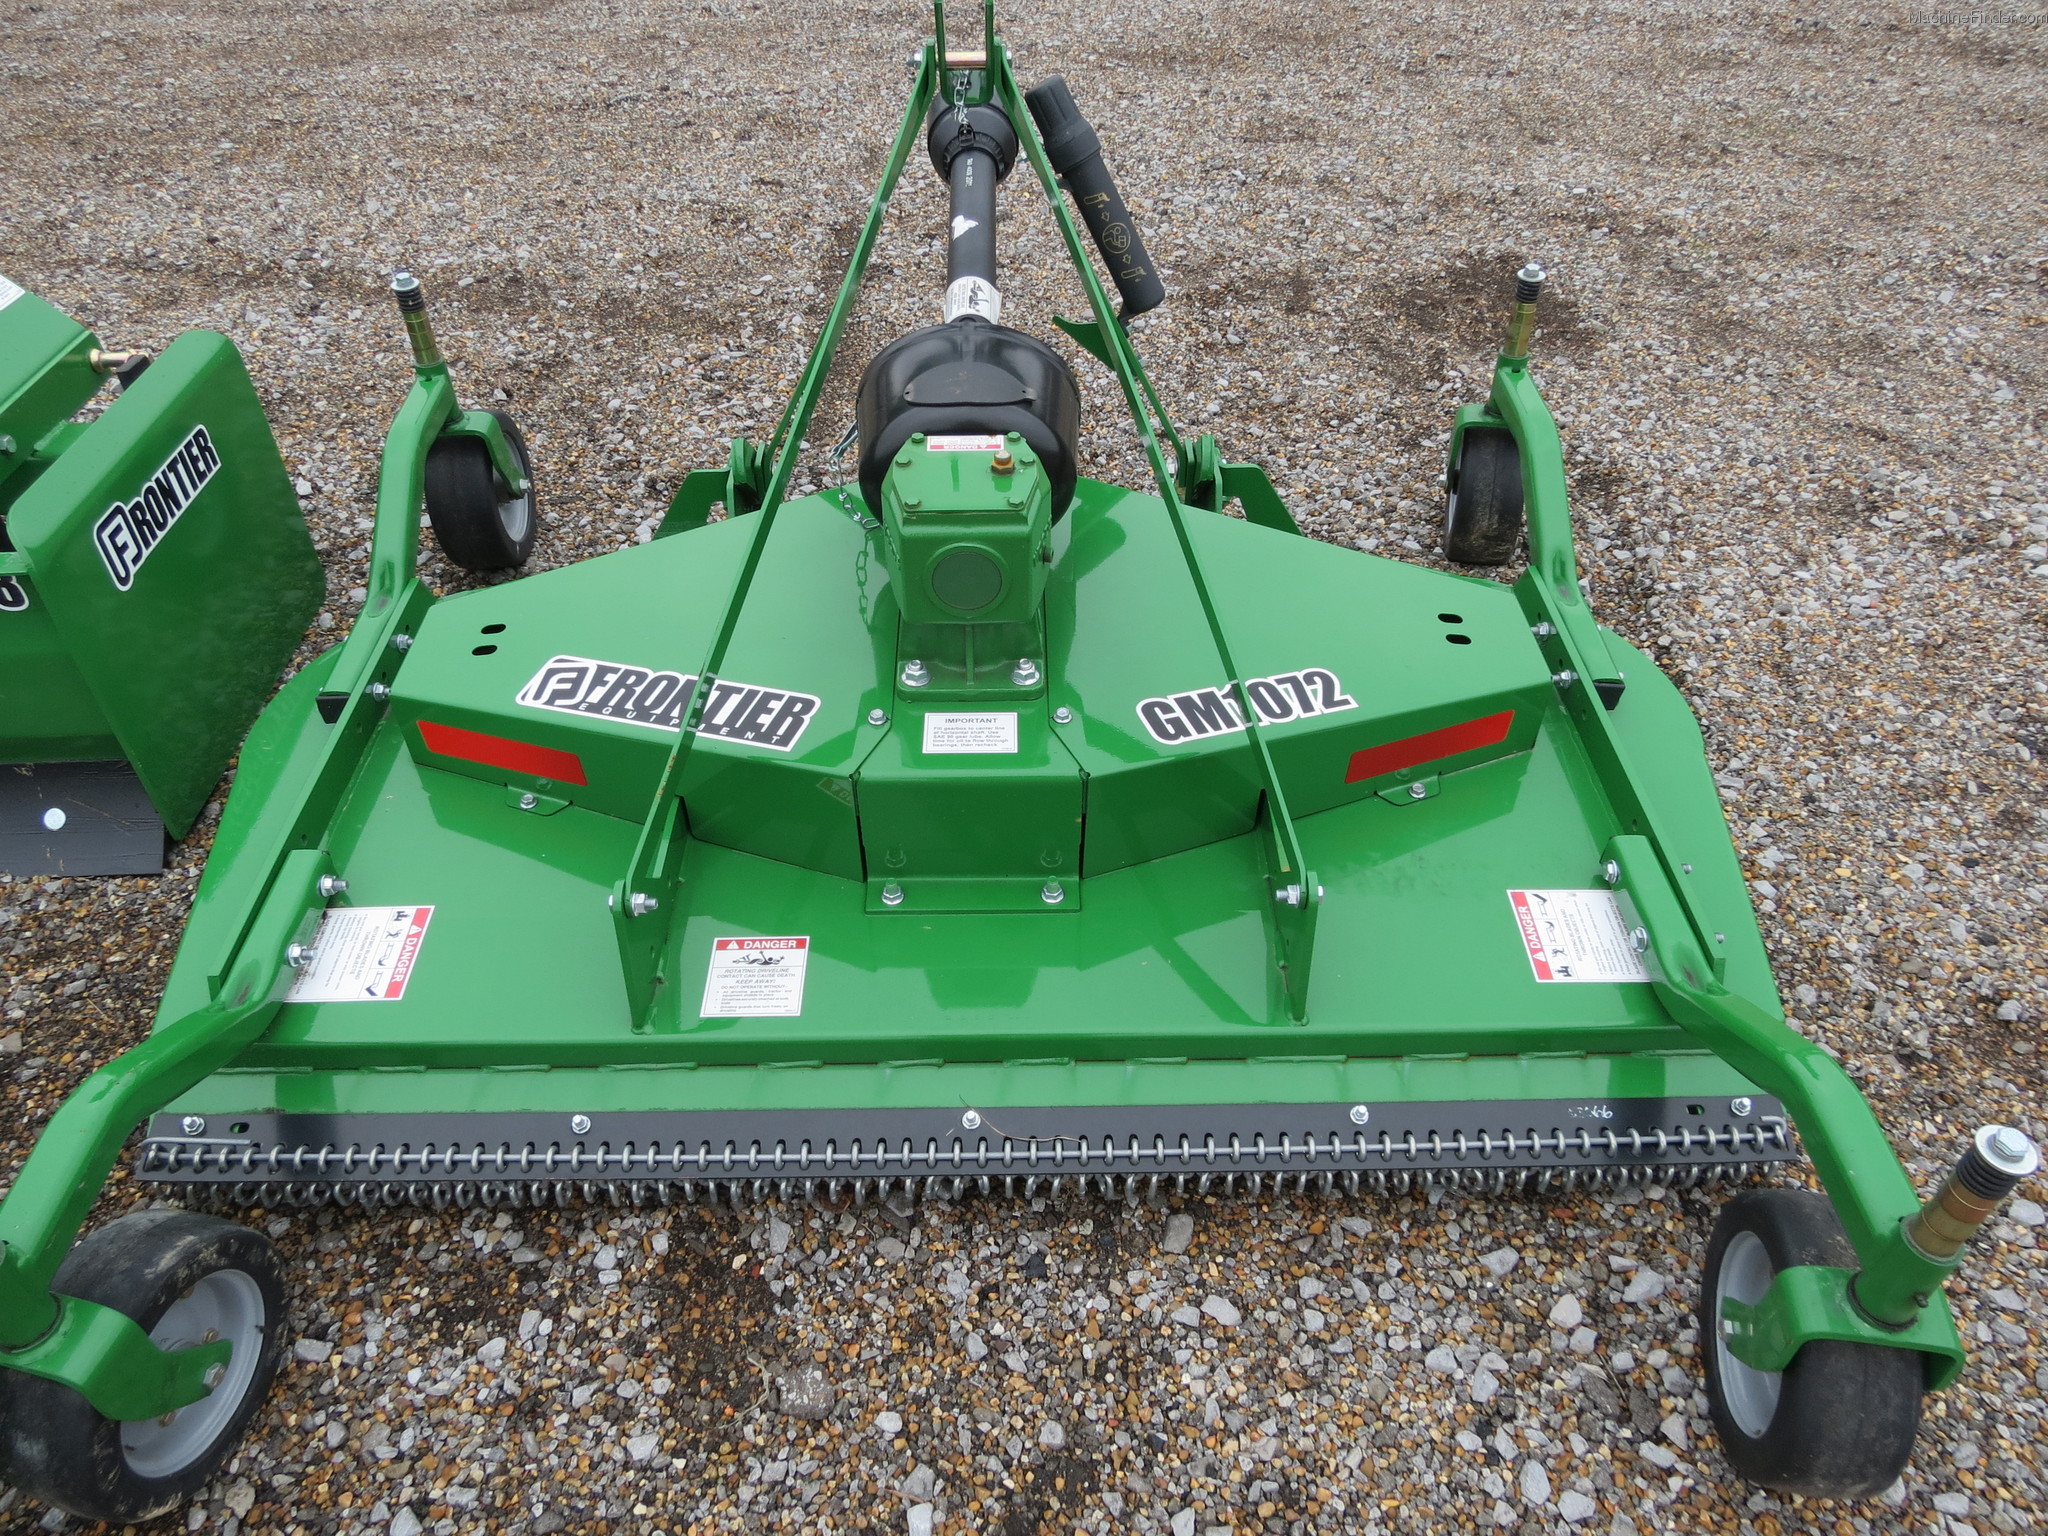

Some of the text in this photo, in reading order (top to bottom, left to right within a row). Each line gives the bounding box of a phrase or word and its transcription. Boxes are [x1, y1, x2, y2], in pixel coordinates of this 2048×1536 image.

[96, 427, 220, 588] FRONTIER
[744, 940, 797, 948] DANGER
[1517, 906, 1542, 948] DANGER
[391, 938, 418, 983] DANGER
